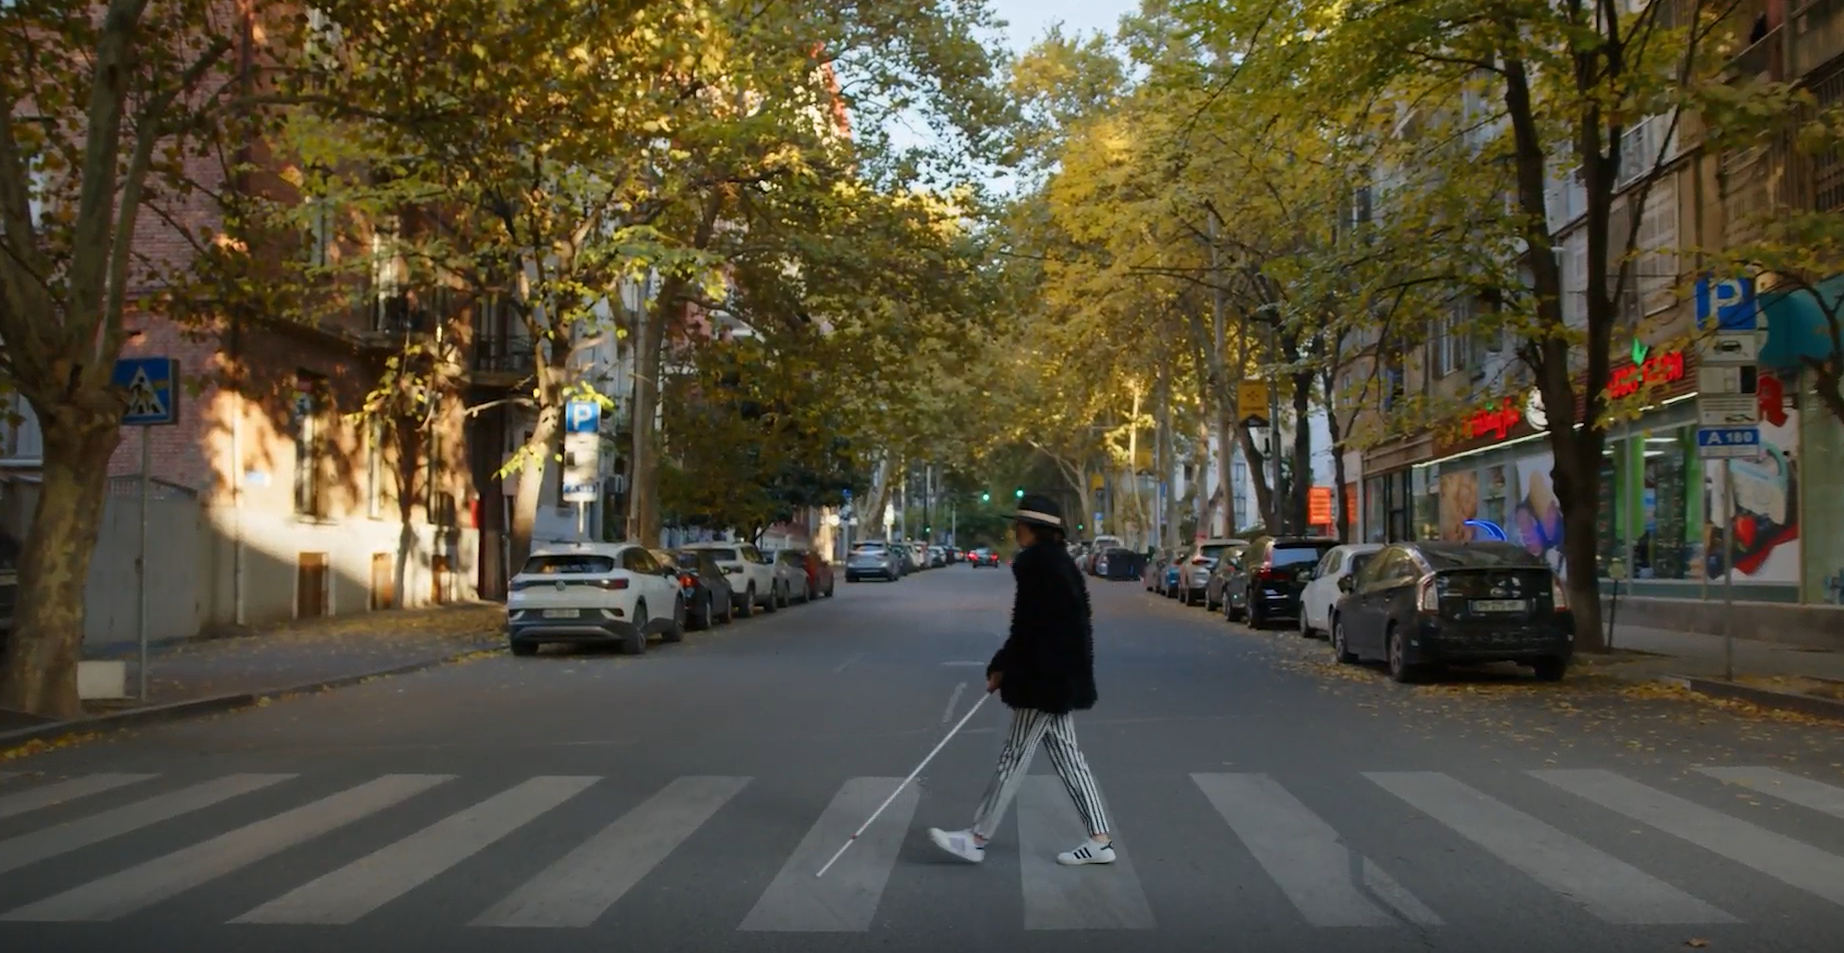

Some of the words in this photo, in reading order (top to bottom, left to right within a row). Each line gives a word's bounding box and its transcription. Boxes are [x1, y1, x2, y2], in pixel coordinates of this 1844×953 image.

[1710, 279, 1743, 320] P
[573, 403, 593, 430] P
[1706, 431, 1722, 444] A
